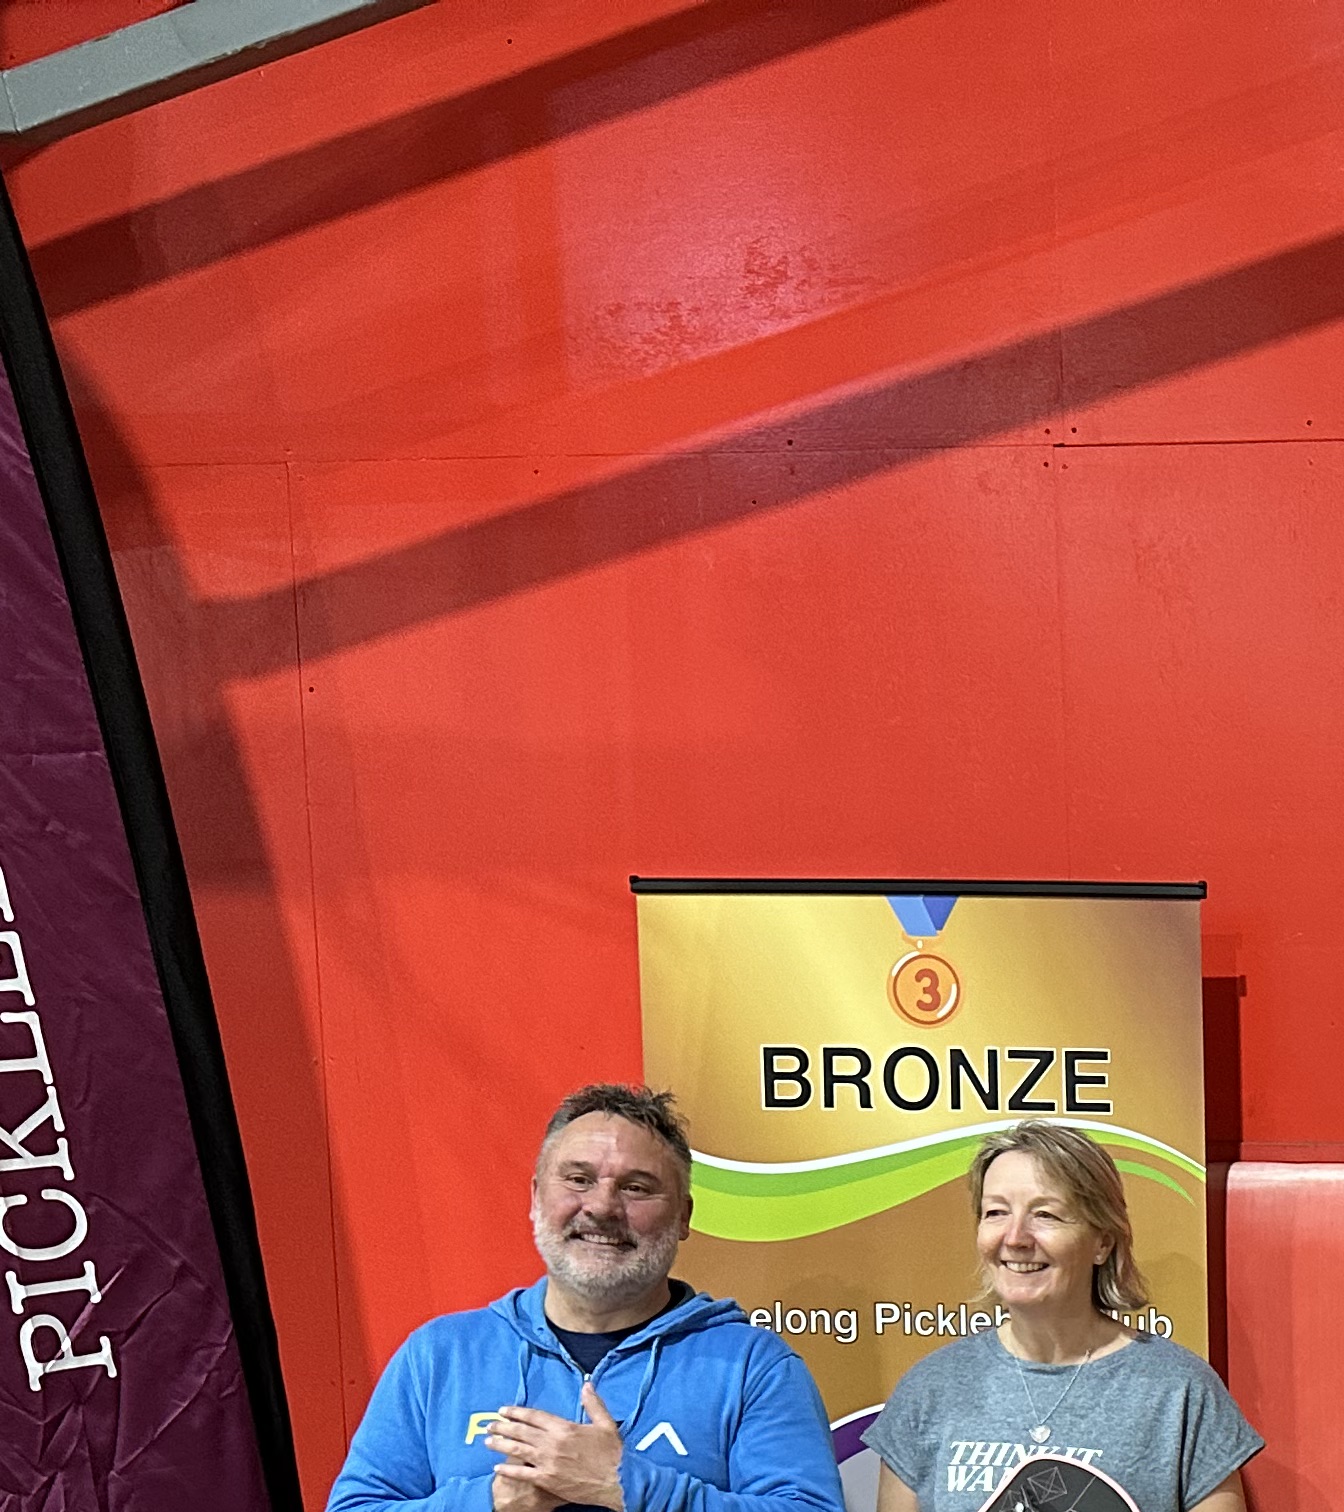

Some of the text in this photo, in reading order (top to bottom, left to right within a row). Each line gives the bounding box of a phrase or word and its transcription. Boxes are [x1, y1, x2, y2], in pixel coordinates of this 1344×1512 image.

[913, 968, 942, 1012] 3
[762, 1045, 1112, 1113] BRONZE
[745, 1301, 858, 1344] elong
